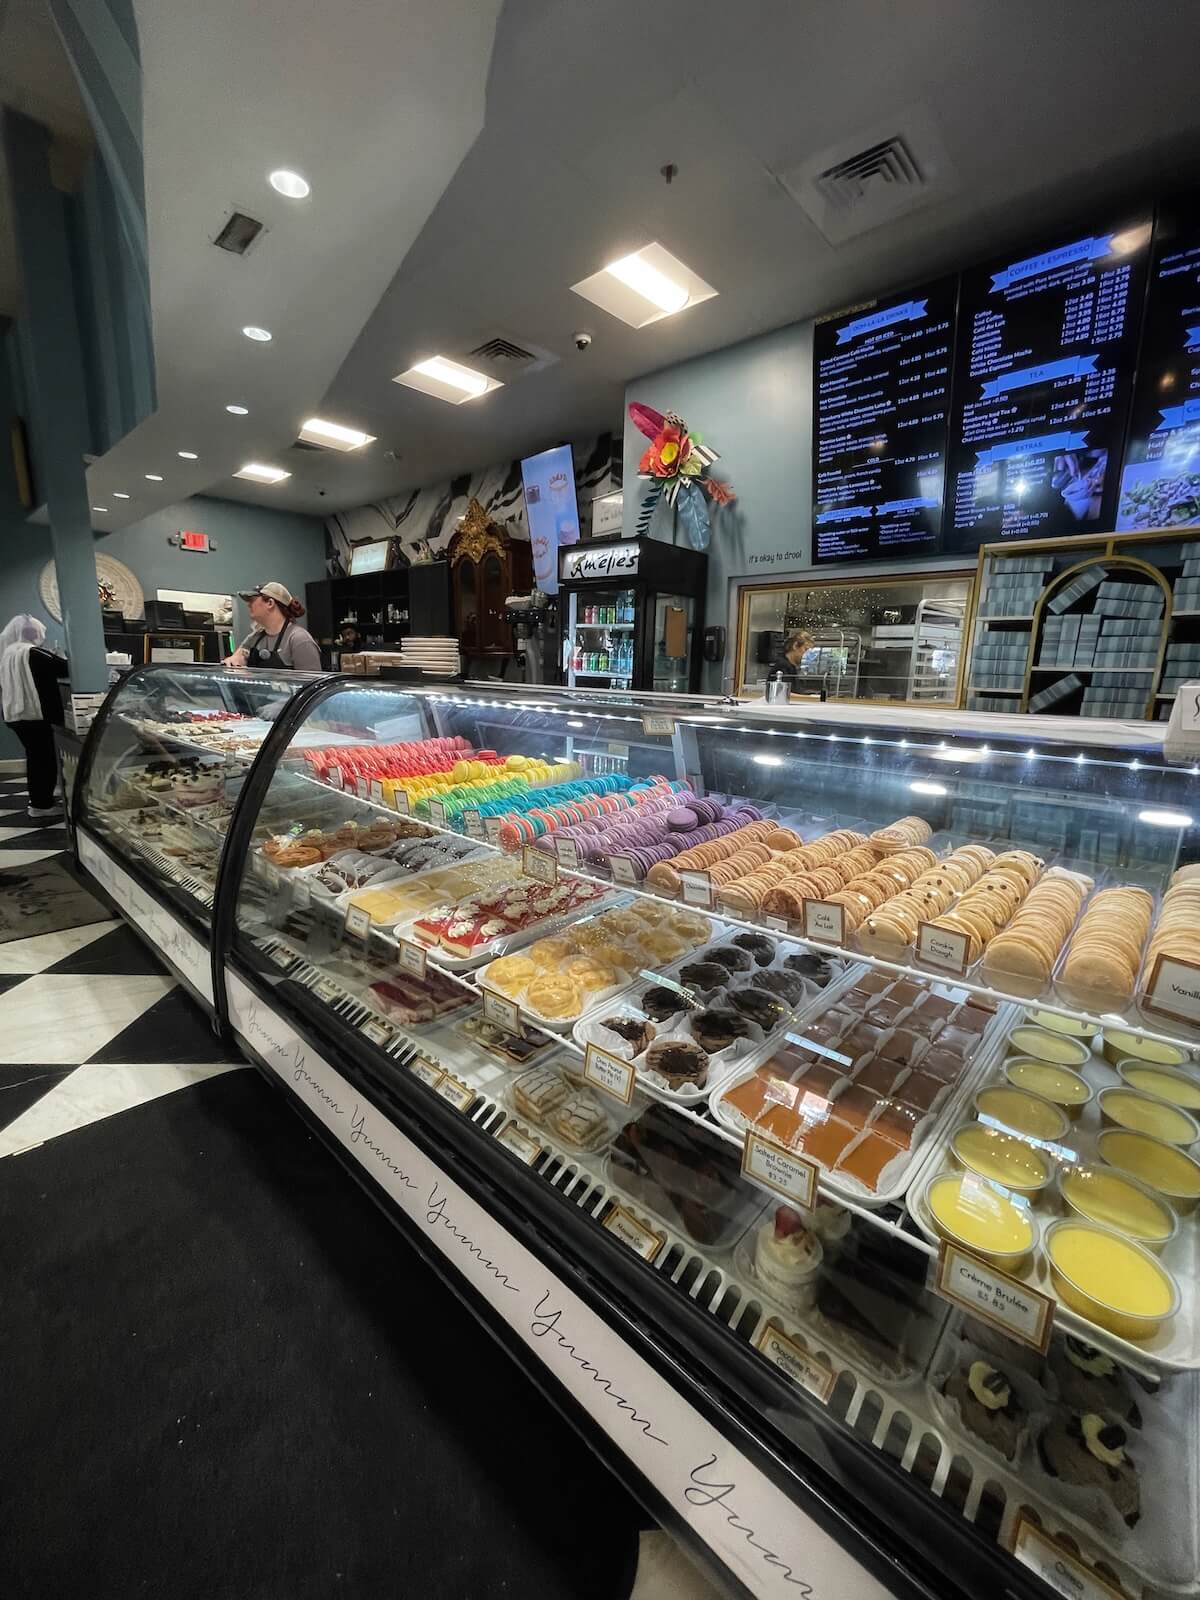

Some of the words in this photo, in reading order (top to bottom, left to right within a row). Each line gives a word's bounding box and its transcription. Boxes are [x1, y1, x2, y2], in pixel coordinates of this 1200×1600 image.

[1029, 370, 1044, 379] TEA
[1015, 441, 1043, 452] EXTRAS
[570, 549, 640, 578] Amélie's
[760, 553, 774, 564] okay
[776, 552, 783, 561] to
[784, 549, 802, 560] drool
[930, 945, 953, 958] Dough
[753, 1144, 776, 1162] Salted
[777, 1156, 806, 1179] Caramel
[765, 1159, 793, 1180] Brownie
[959, 1267, 993, 1293] Crème
